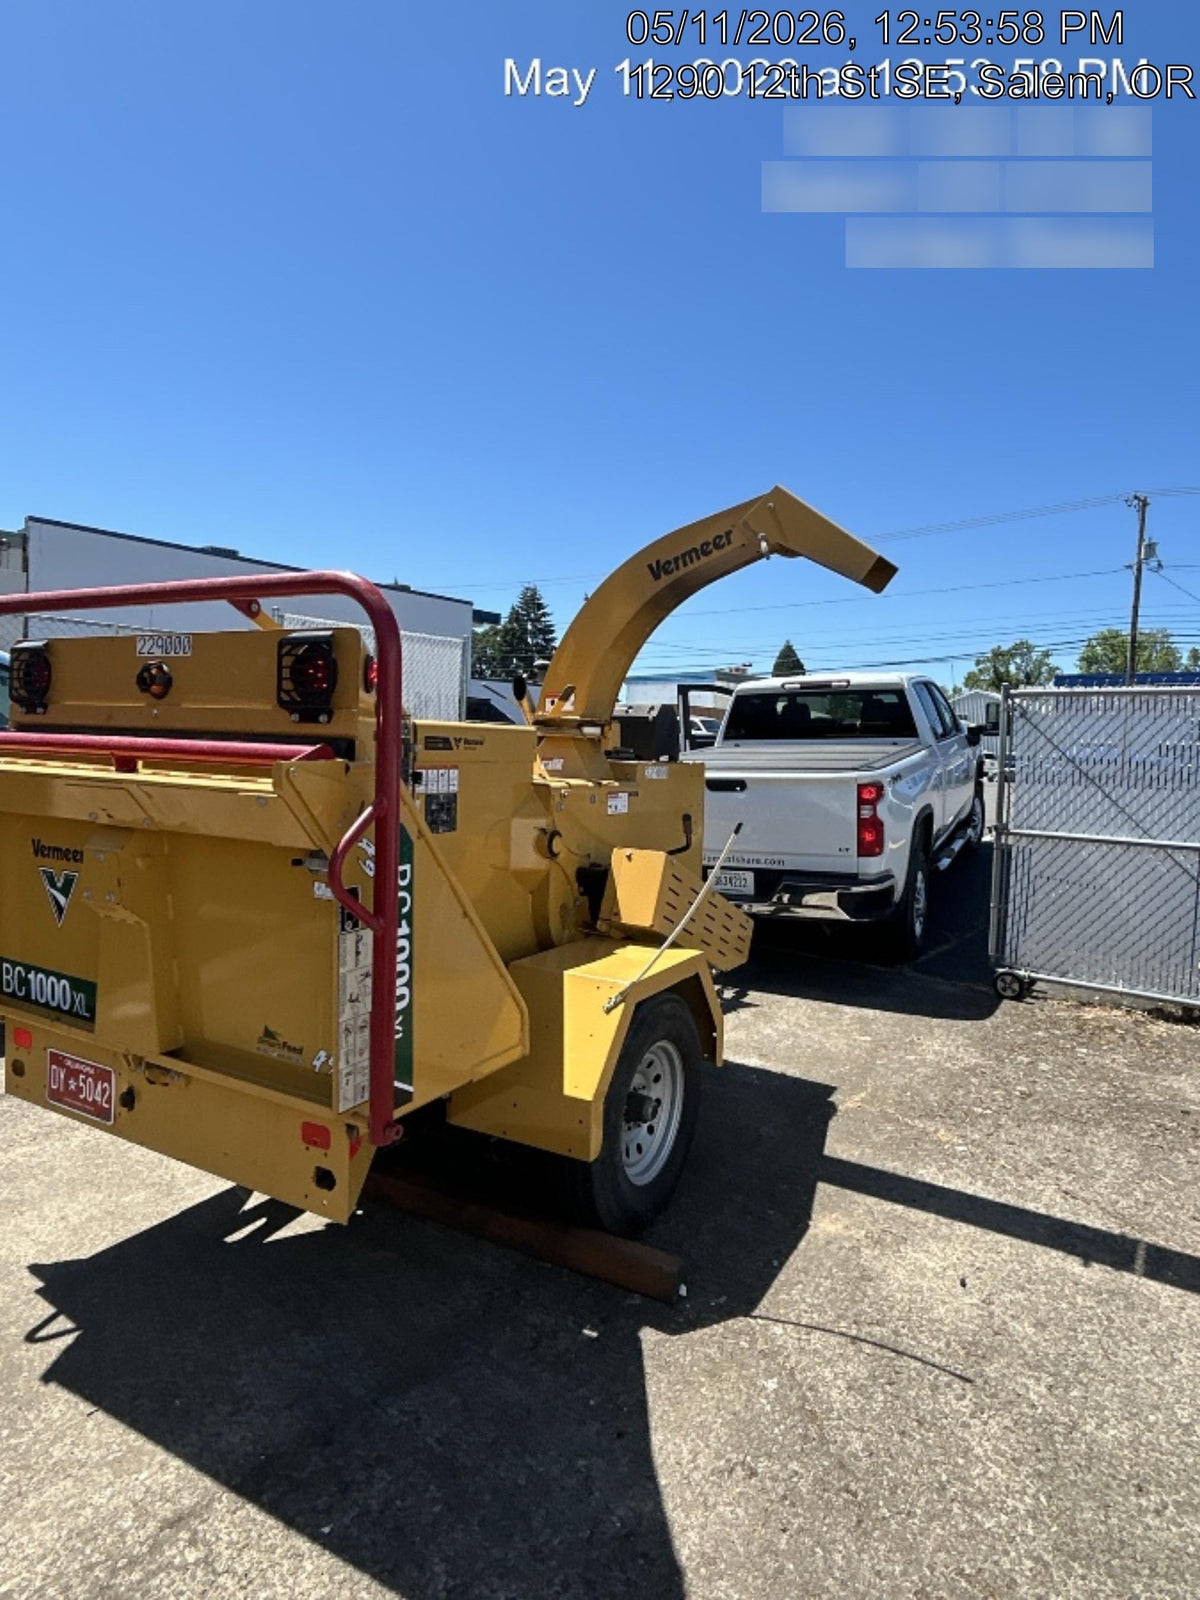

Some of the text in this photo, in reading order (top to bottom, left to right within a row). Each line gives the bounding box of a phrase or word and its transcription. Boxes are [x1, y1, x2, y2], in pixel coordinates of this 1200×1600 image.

[646, 528, 733, 581] Vermeer
[138, 635, 191, 655] 229000
[31, 838, 84, 865] Vermeer
[79, 1074, 111, 1109] 5042
